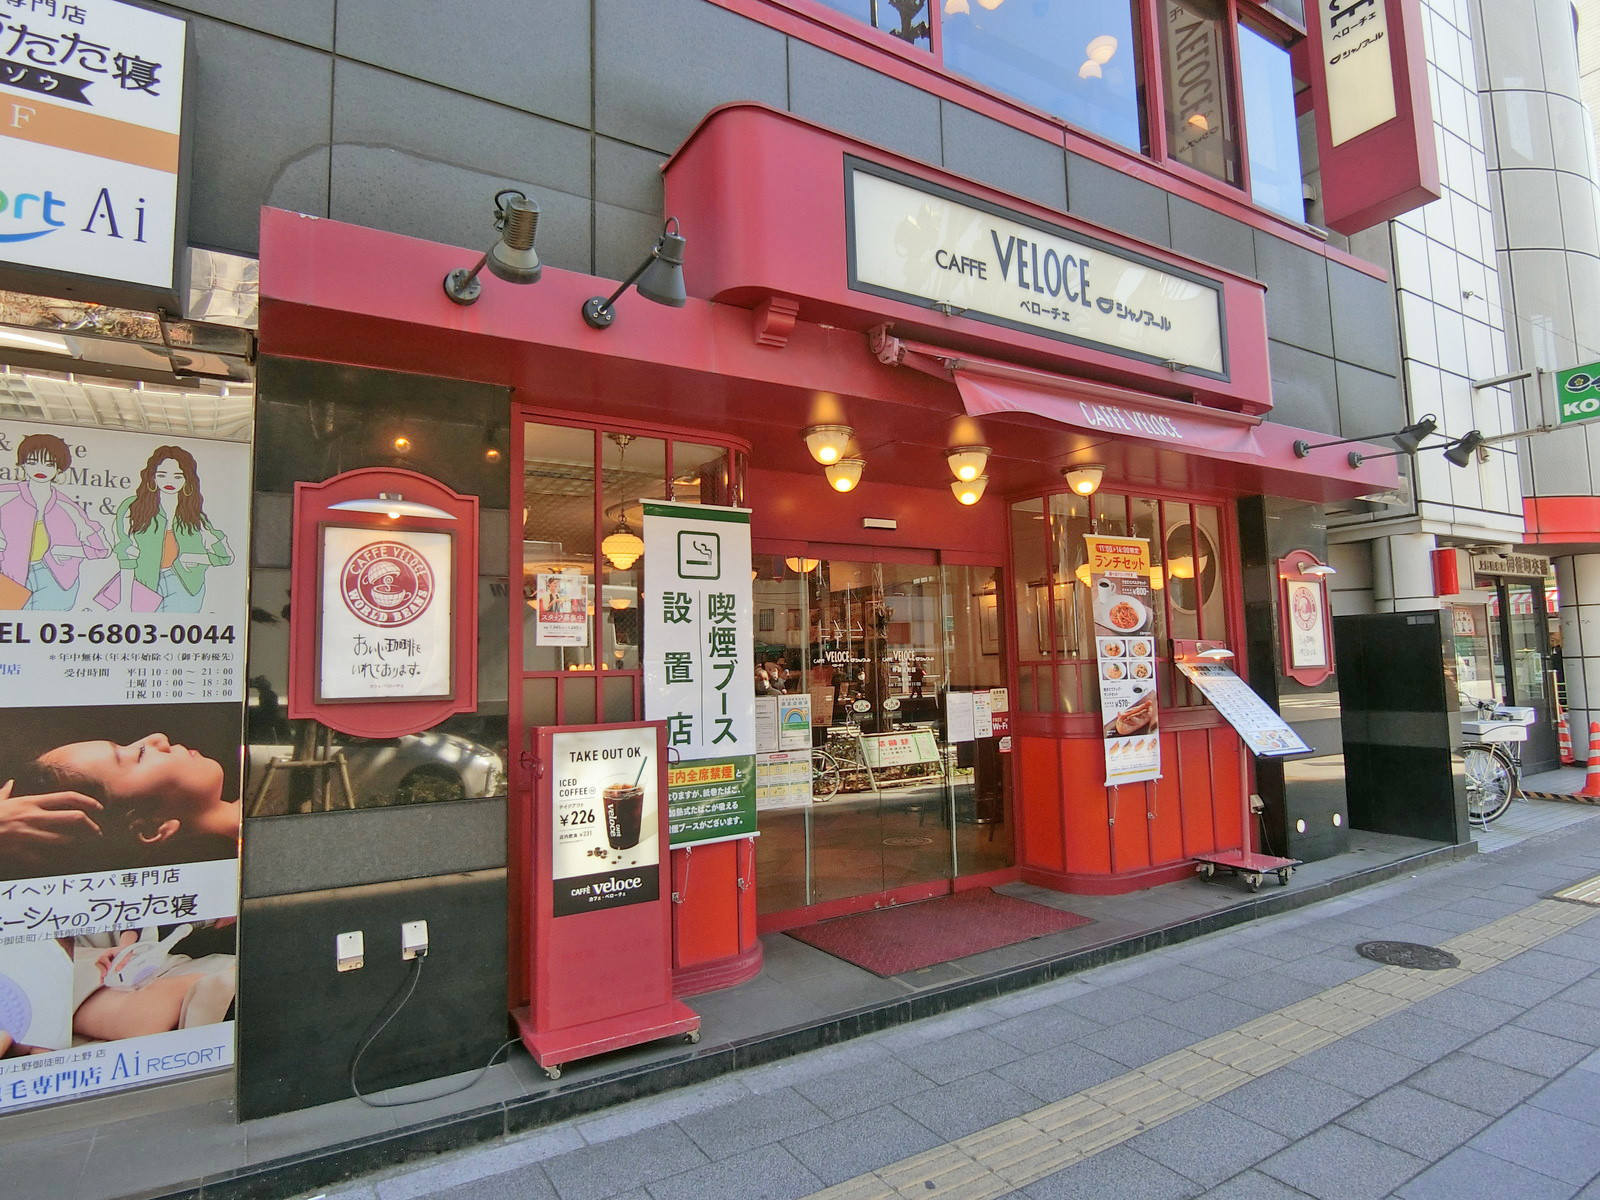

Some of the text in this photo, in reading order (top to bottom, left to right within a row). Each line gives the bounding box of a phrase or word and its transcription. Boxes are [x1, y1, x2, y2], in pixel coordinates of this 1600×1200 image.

[1332, 11, 1376, 40] ベローチェ
[9, 104, 37, 128] F
[81, 187, 147, 244] Ai
[935, 229, 1091, 308] CAFFE VELOCE
[1020, 299, 1070, 323] ベローチェ
[1116, 302, 1172, 332] シャノアール
[1563, 398, 1600, 416] KO
[1123, 408, 1183, 440] VELOCE
[69, 467, 131, 489] Make
[393, 547, 427, 577] VELOCE
[1095, 555, 1145, 571] ランチセット
[348, 588, 428, 622] WORLD BEANS
[40, 622, 236, 645] 03-6803-0044
[825, 650, 849, 663] VELOCE
[64, 668, 110, 678] 受付時間
[127, 668, 147, 677] 平日
[663, 591, 693, 747] 設置店
[708, 593, 738, 745] 喫煙ブース
[126, 679, 147, 688] 土曜
[126, 690, 147, 699] 日祝
[569, 746, 642, 763] TAKE OUT OK
[559, 778, 577, 788] ICED
[559, 787, 588, 798] COFFEE
[560, 809, 595, 827] ¥226
[592, 876, 642, 896] veloce
[110, 1045, 226, 1081] Ai RESORT
